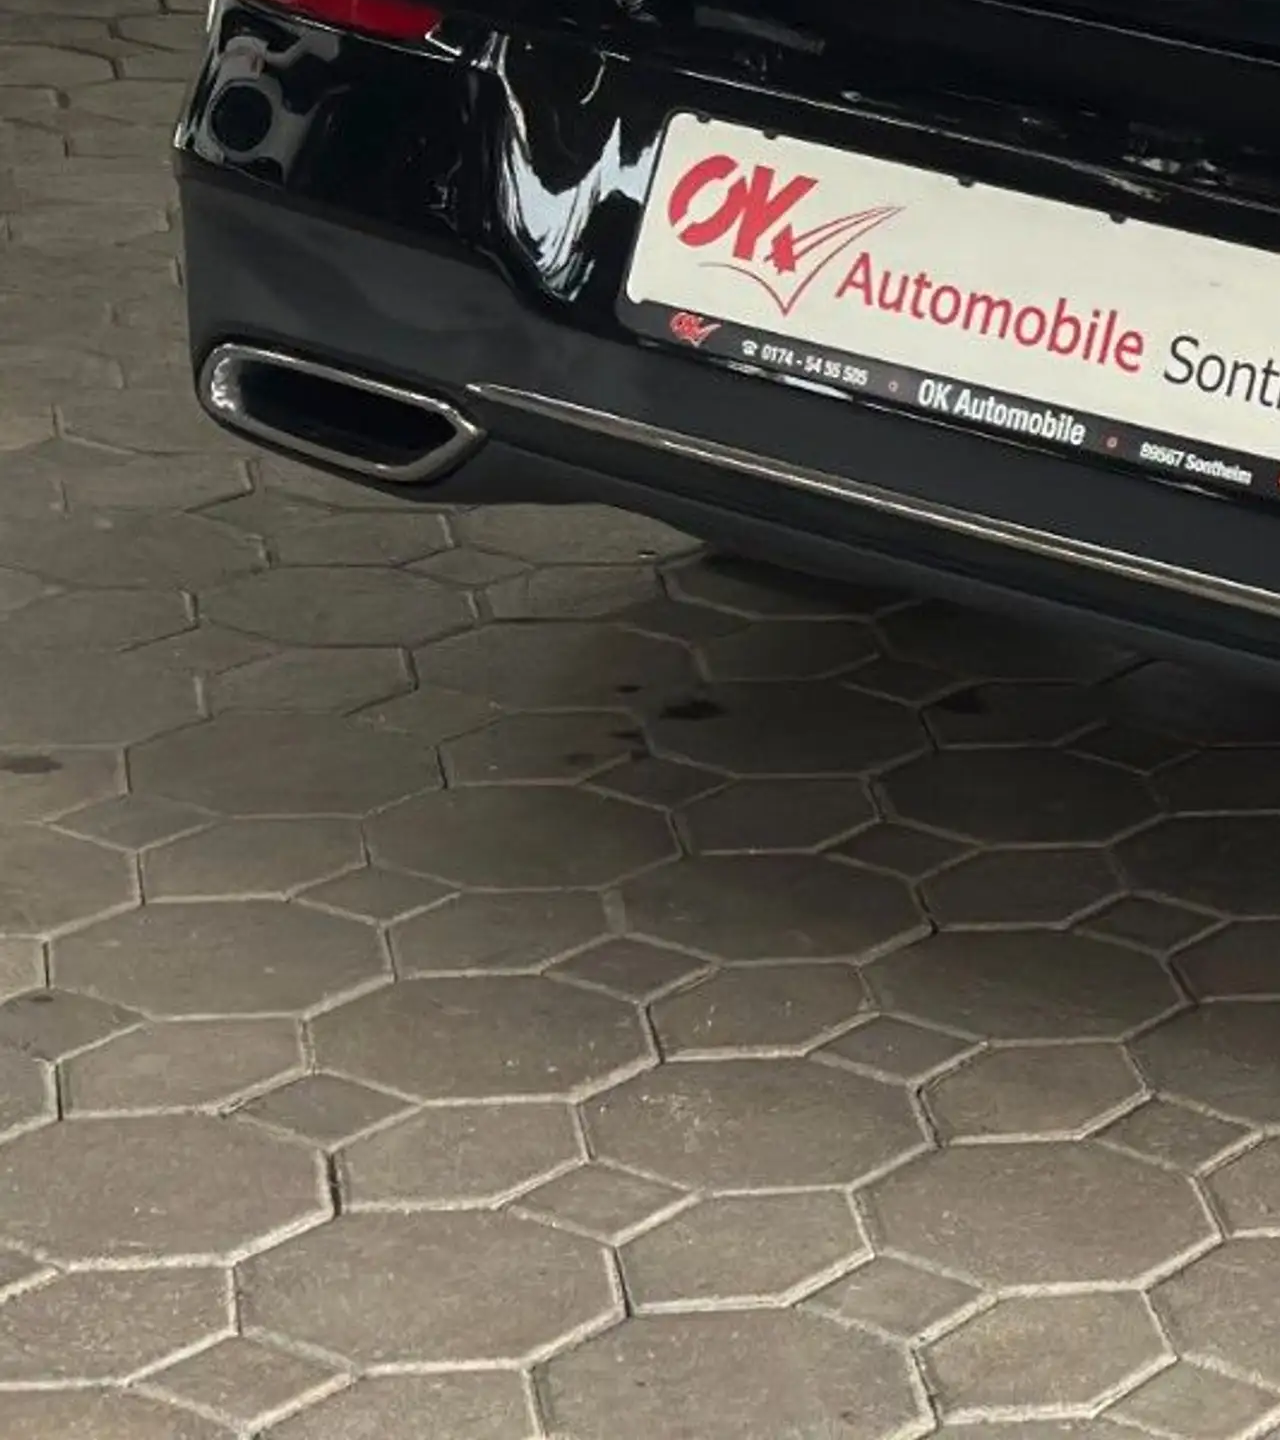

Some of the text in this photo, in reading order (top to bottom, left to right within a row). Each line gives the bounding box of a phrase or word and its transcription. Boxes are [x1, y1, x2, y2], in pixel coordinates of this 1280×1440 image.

[668, 155, 819, 274] OK
[835, 252, 1145, 373] Automobile
[761, 344, 793, 366] 0174
[917, 378, 1086, 445] OK Automobile
[1184, 454, 1252, 485] Sontheim
